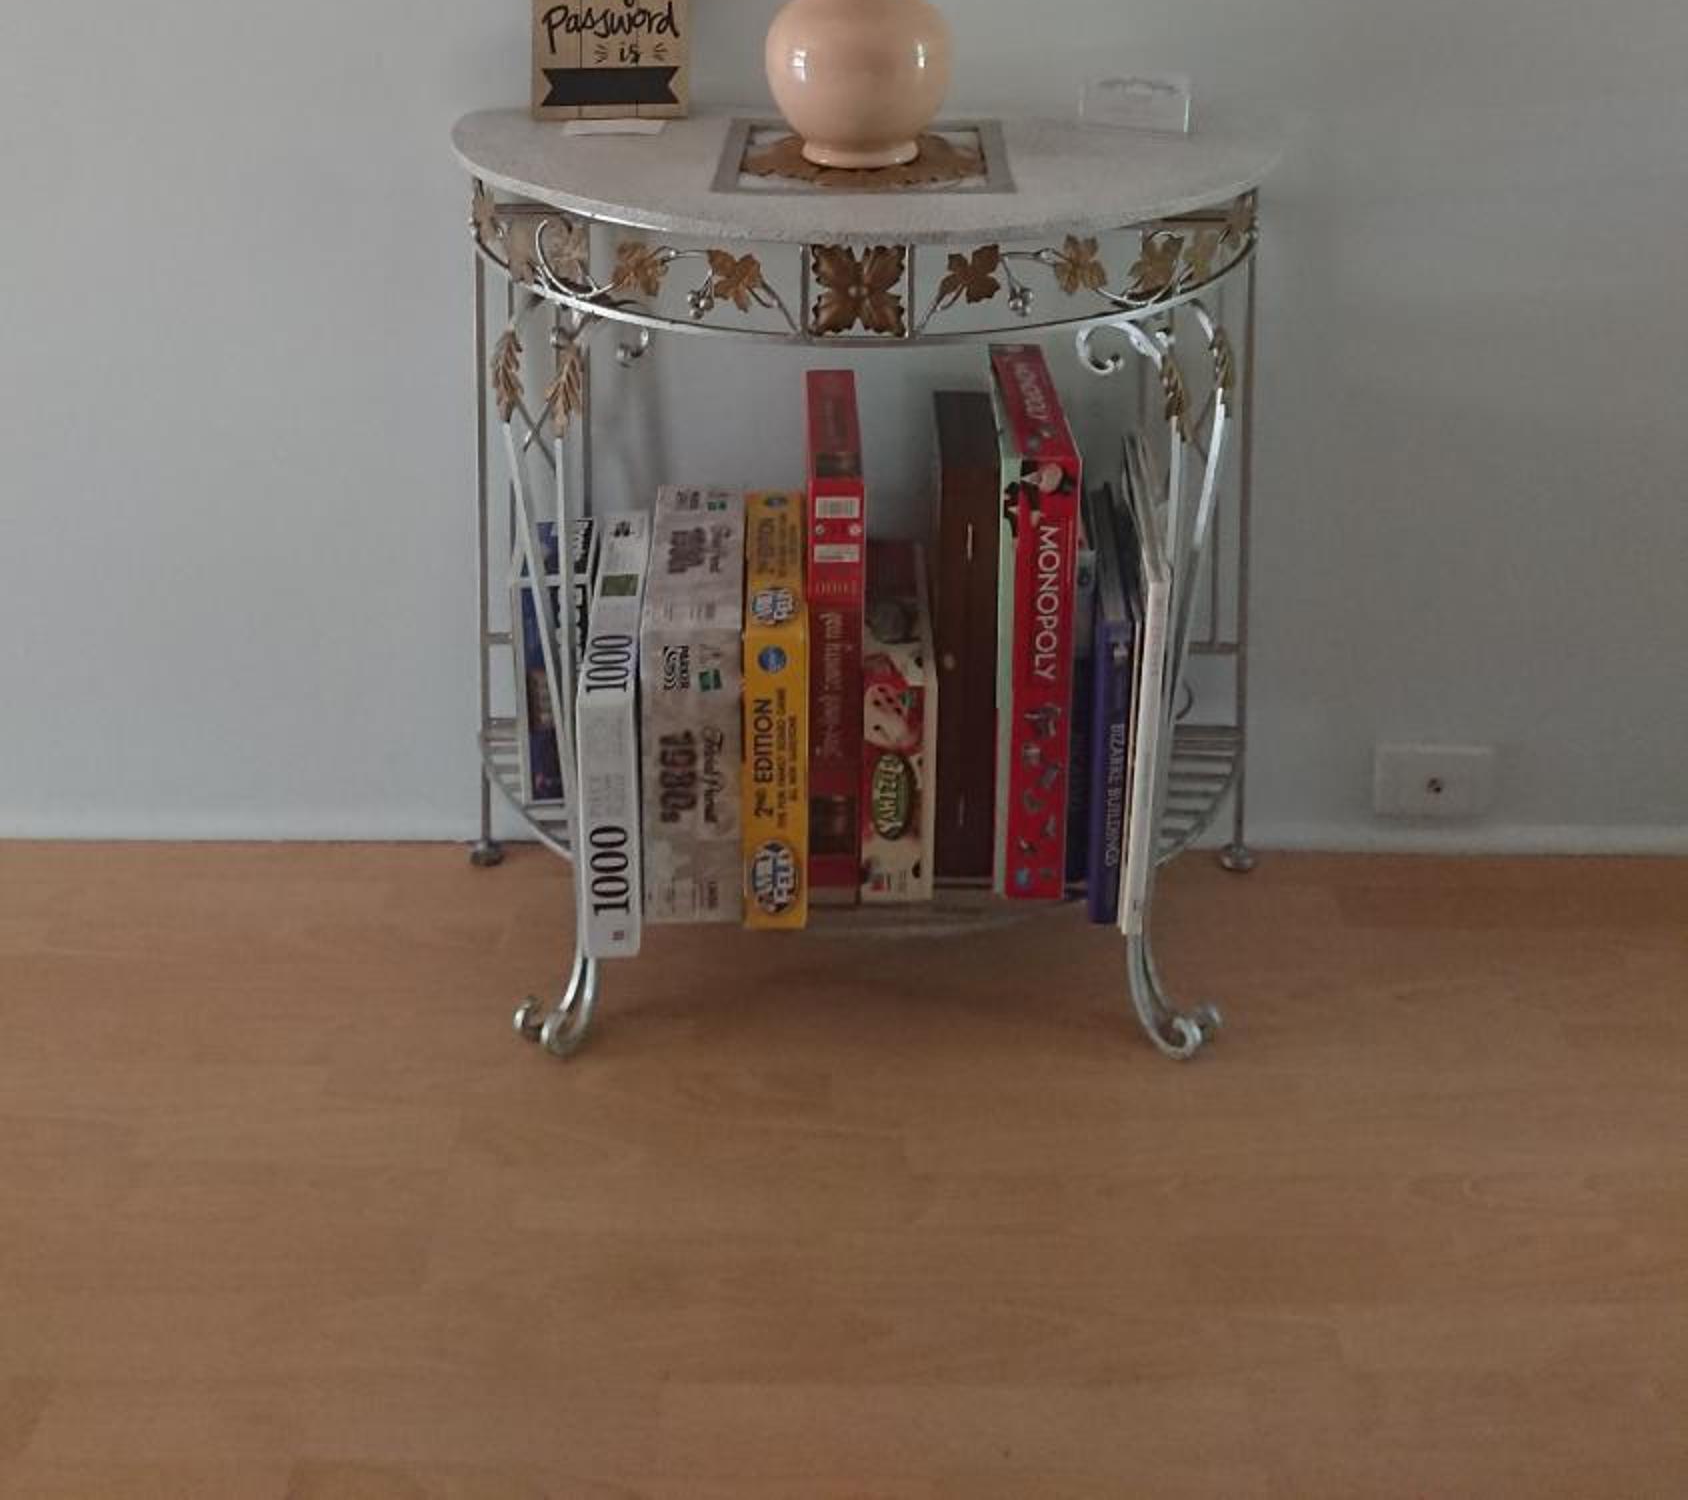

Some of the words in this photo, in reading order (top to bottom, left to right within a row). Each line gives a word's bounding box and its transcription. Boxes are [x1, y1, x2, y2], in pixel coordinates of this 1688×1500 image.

[618, 41, 641, 64] is
[1031, 523, 1061, 684] MONOPOLY
[584, 633, 633, 695] 1000
[753, 697, 774, 784] EDITION
[1108, 722, 1126, 784] BIZARRE
[1104, 786, 1123, 868] BUILDINGS
[588, 825, 630, 917] 1000
